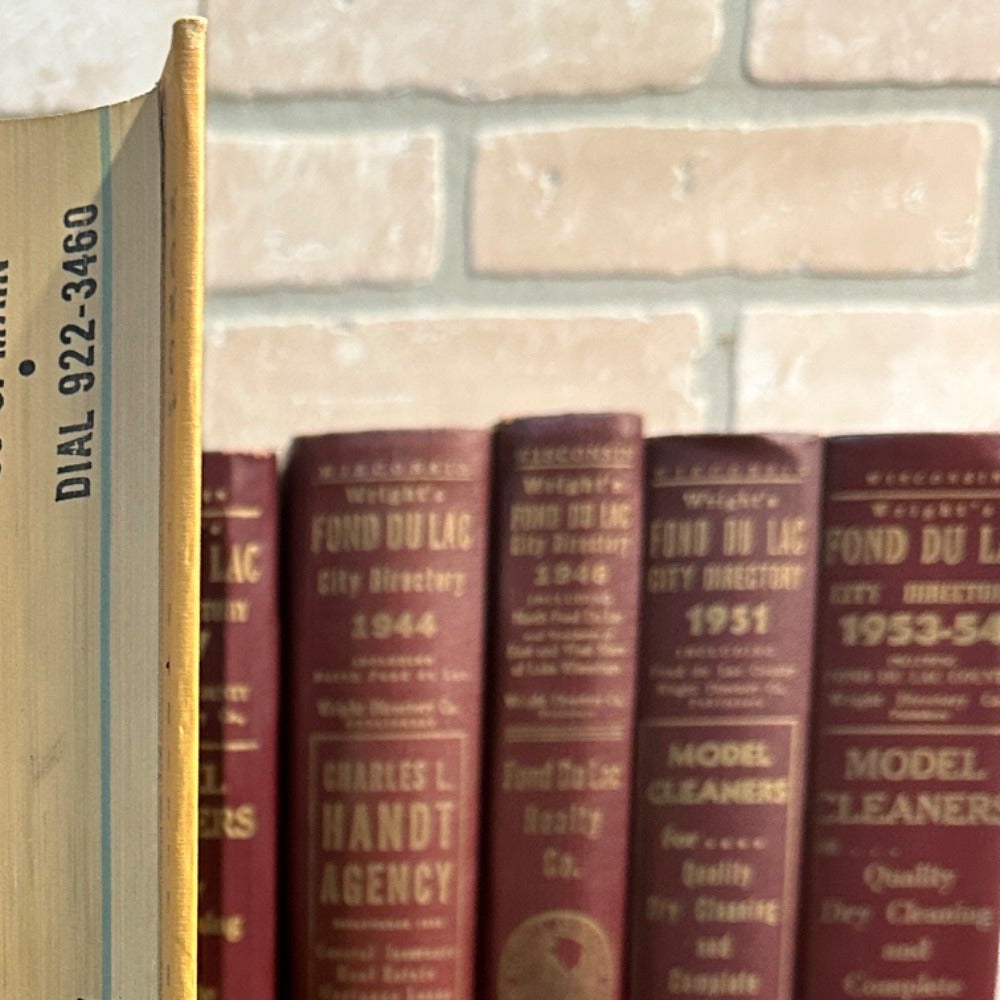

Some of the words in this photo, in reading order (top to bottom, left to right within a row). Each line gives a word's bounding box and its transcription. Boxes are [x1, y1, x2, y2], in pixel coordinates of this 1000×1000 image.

[58, 203, 99, 395] 922-3460
[55, 409, 95, 502] DIAL
[310, 513, 382, 554] FOND
[386, 512, 423, 552] DU
[428, 510, 474, 551] LAC
[825, 523, 910, 566] FOND
[919, 523, 967, 565] DU
[351, 609, 440, 640] 1944
[685, 602, 772, 637] 1951
[667, 739, 774, 769] MODEL
[844, 747, 989, 781] MODEL
[323, 759, 427, 793] CHARLES
[647, 775, 791, 806] CLEANERS
[322, 802, 455, 852] HANDT
[319, 860, 456, 906] AGENCY
